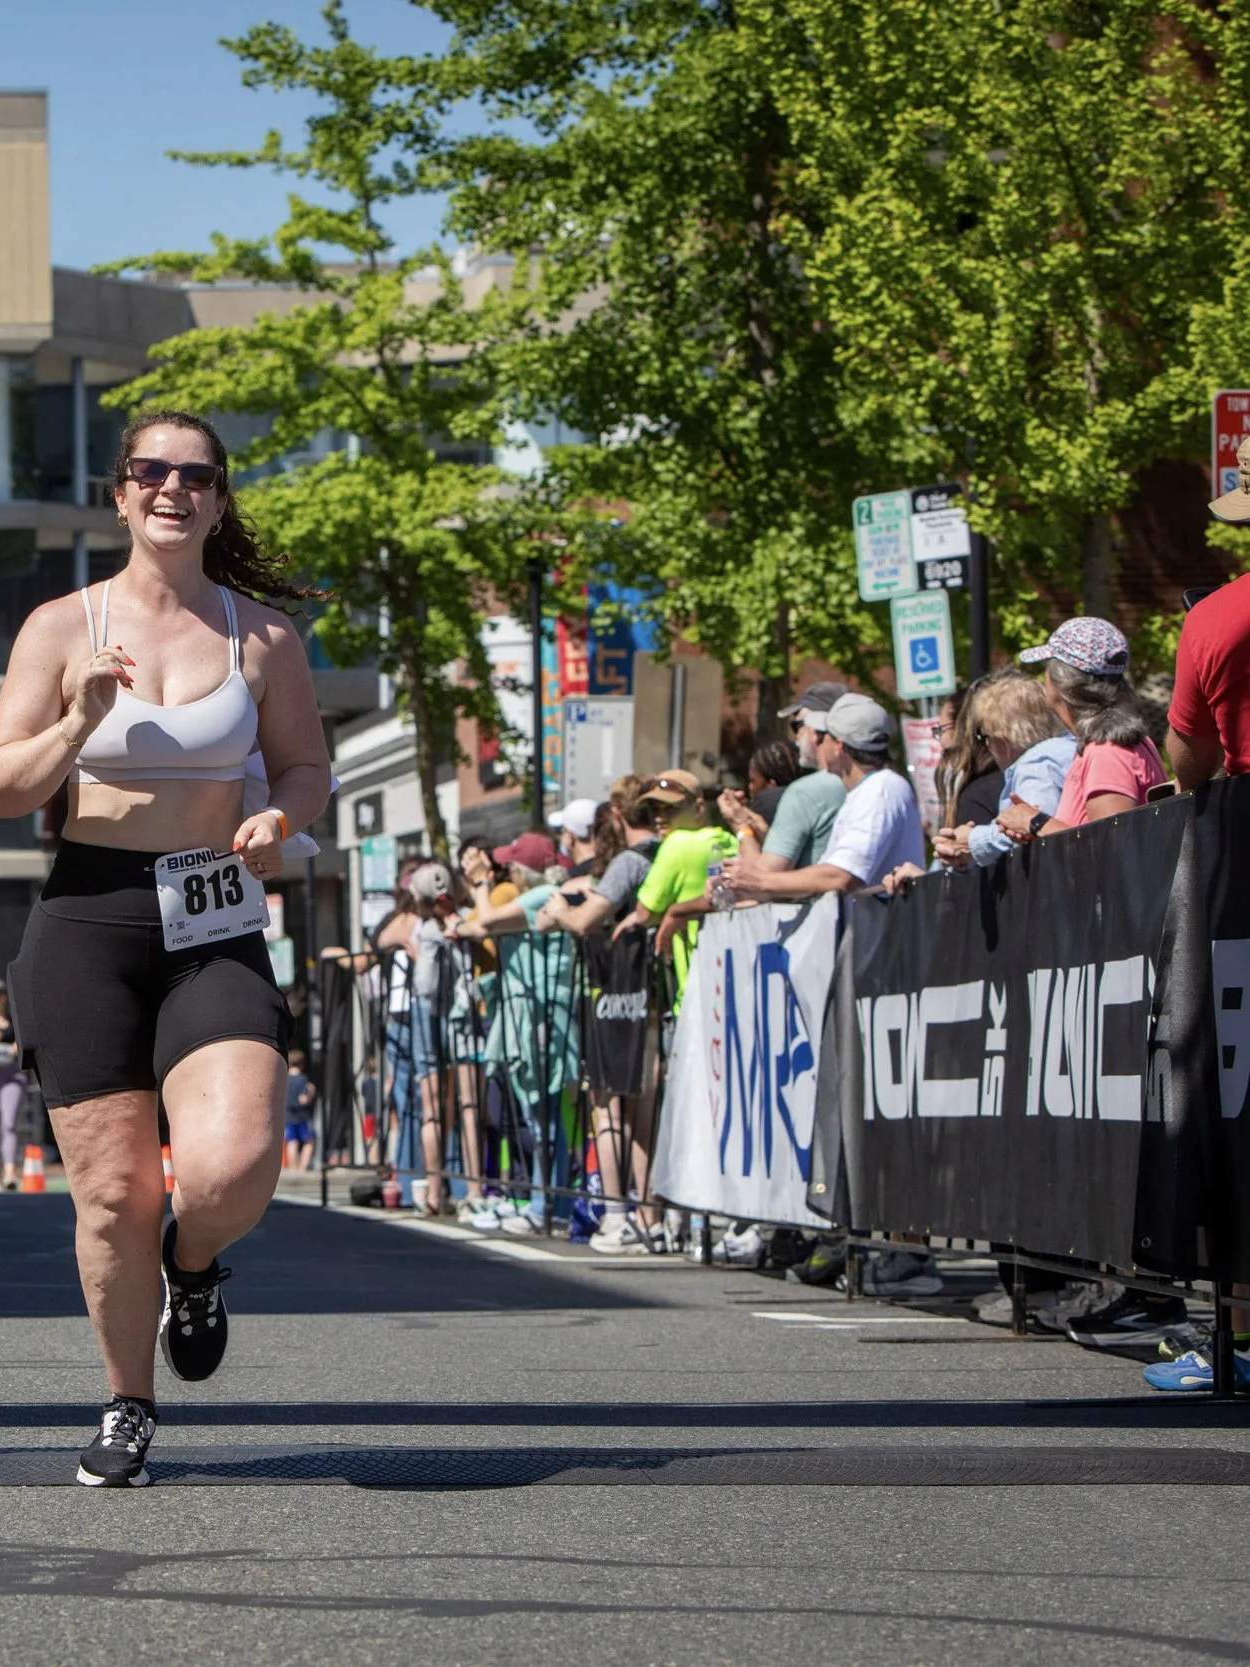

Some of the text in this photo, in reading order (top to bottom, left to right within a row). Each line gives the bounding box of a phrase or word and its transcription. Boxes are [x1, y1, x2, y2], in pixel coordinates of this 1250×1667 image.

[184, 864, 244, 916] 813
[243, 917, 264, 929] DRINK
[208, 926, 231, 937] DRINK
[172, 935, 194, 945] FOOD
